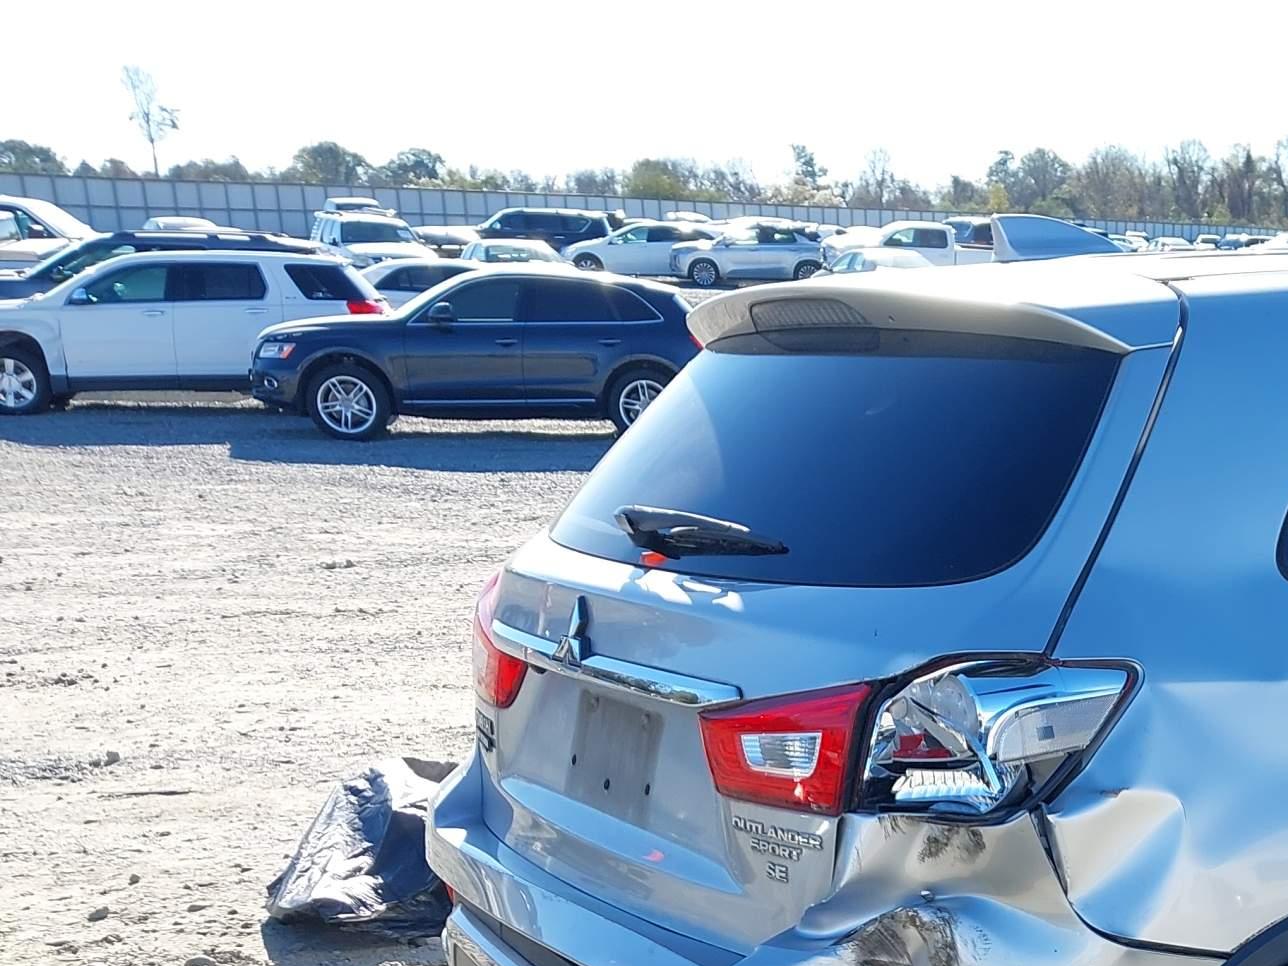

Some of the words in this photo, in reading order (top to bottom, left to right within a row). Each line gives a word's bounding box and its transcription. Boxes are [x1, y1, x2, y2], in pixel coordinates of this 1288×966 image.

[731, 815, 824, 850] OUTLANDER
[750, 837, 803, 861] SPORT
[767, 861, 789, 883] SE
